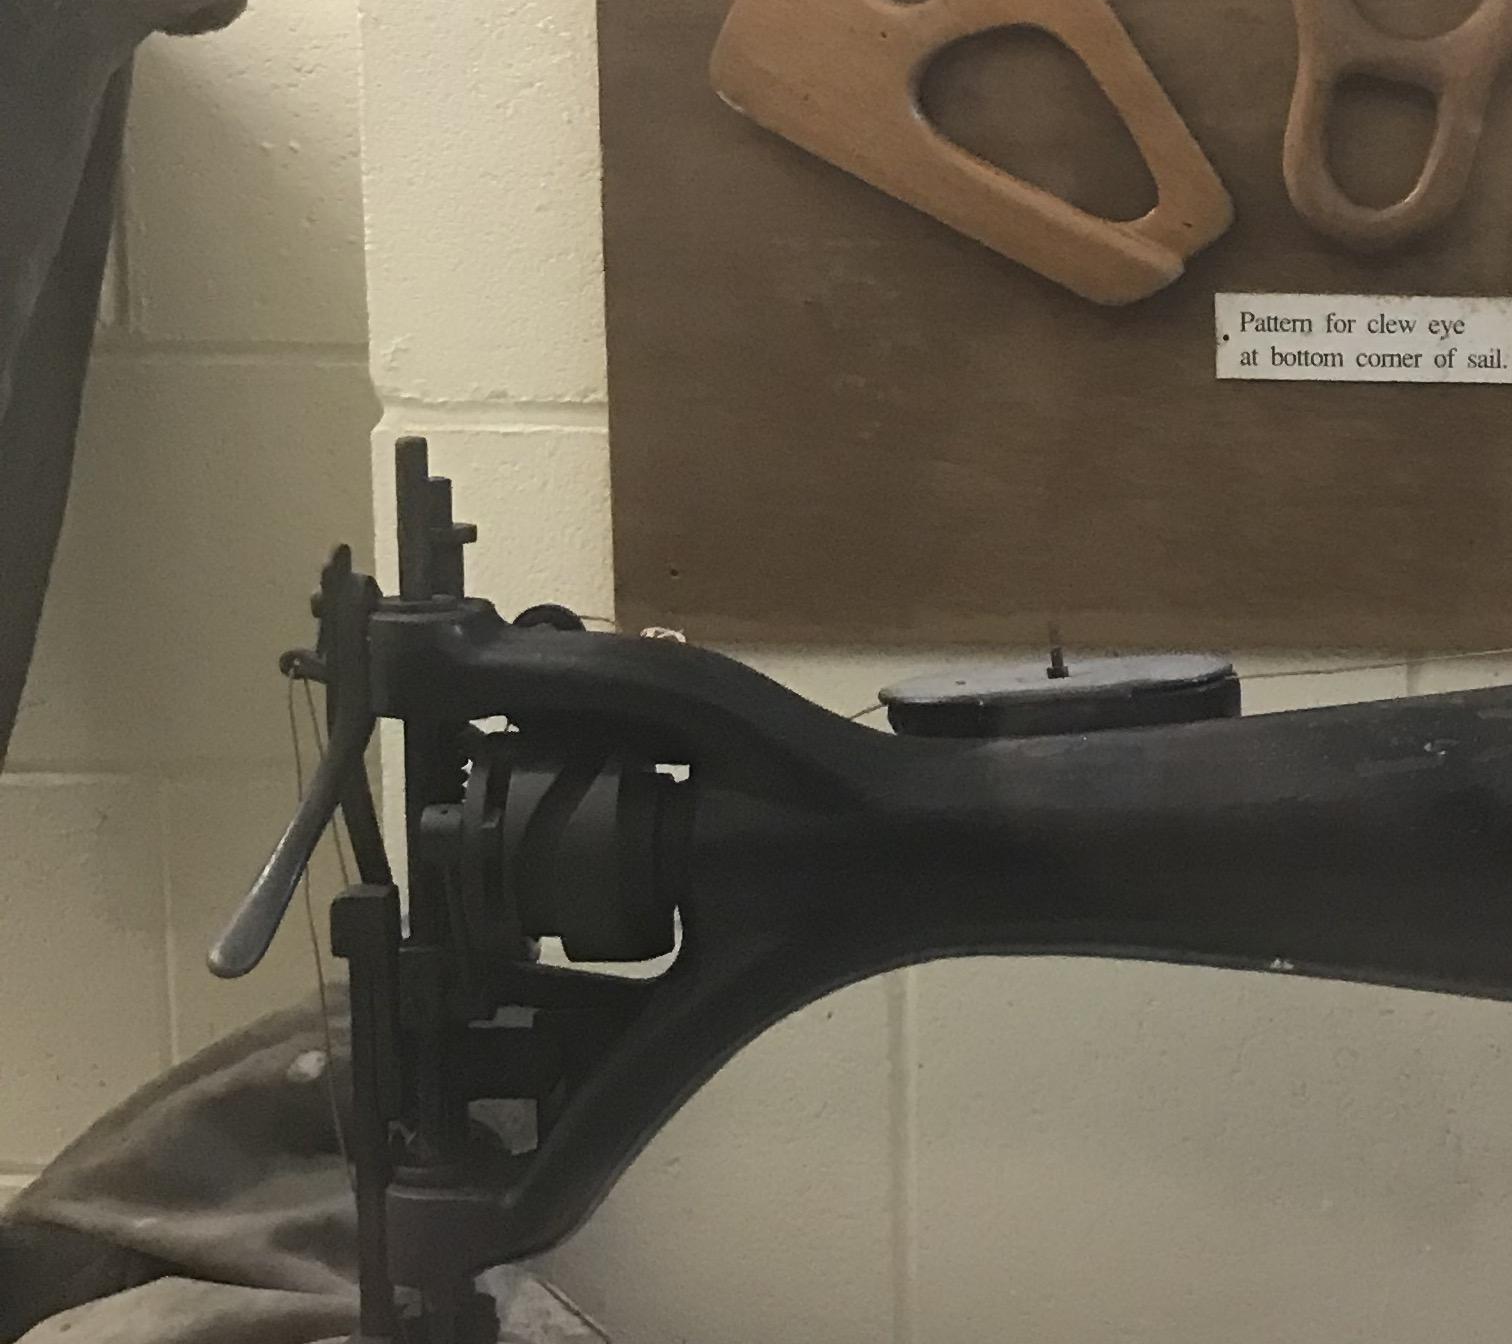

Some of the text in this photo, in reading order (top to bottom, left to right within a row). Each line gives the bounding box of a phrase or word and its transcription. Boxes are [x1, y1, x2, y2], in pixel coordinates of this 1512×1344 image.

[1239, 311, 1466, 341] Pattern for clew eye
[1239, 345, 1508, 370] at bottom corner of sail.
